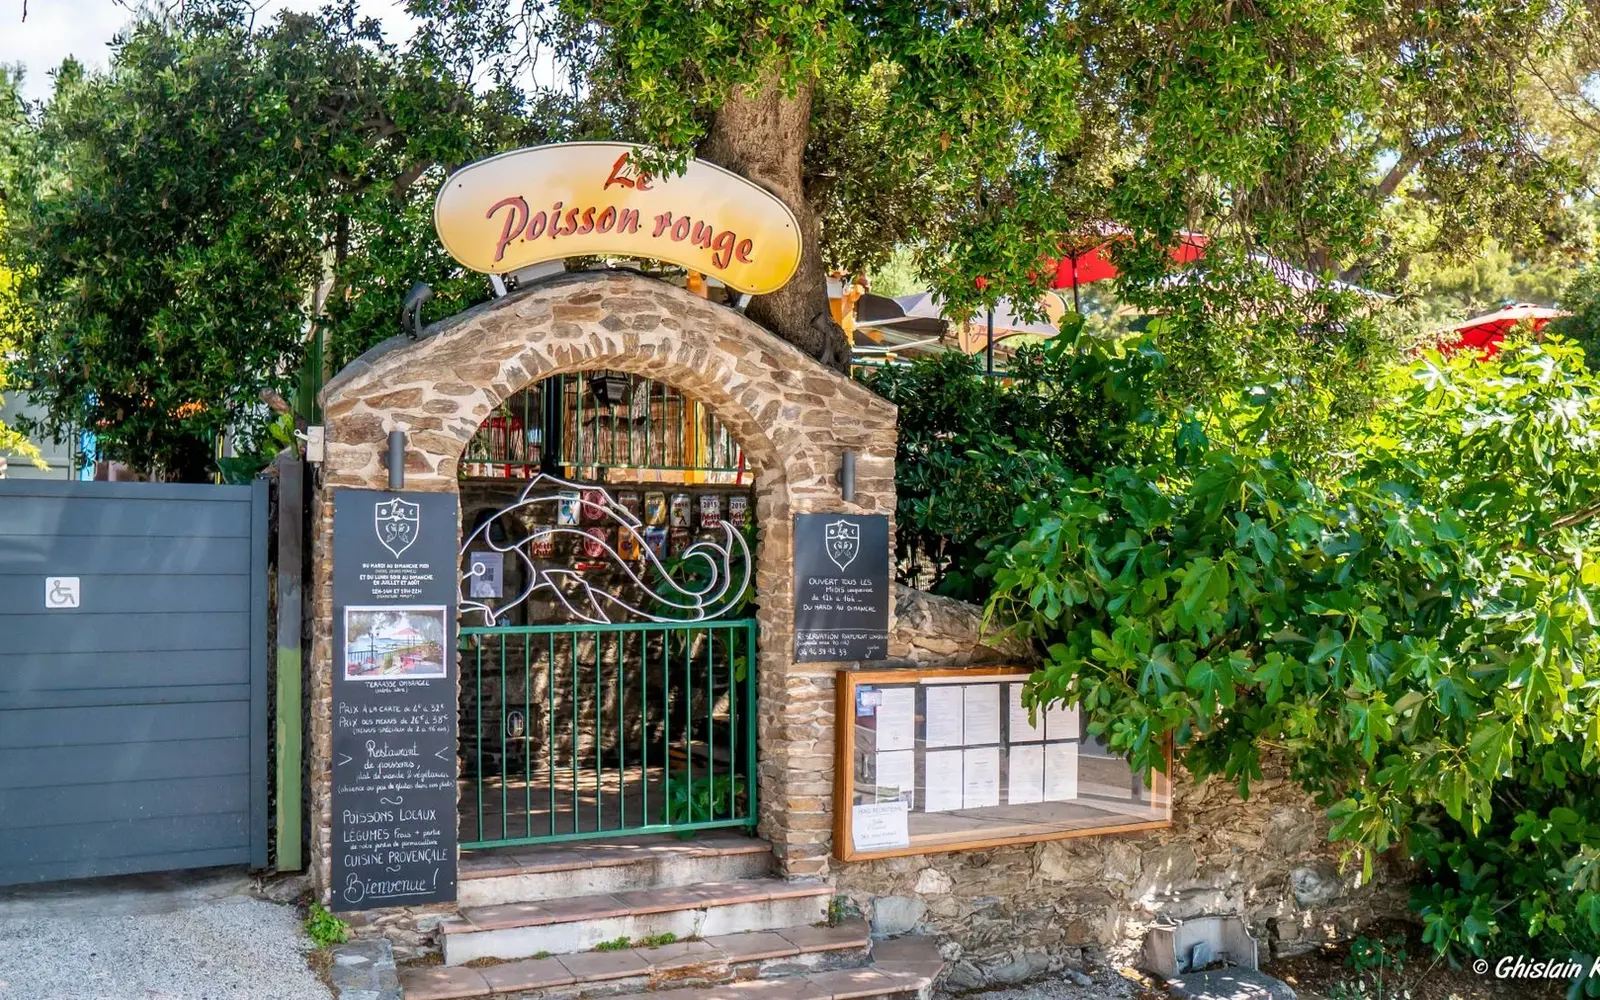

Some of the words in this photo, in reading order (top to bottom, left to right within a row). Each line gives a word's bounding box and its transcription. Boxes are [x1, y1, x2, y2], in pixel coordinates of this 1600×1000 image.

[604, 151, 655, 193] Le
[486, 195, 640, 262] Poisson
[654, 212, 753, 269] rouge
[408, 578, 421, 586] AOÛT
[809, 578, 838, 586] OUVERT
[825, 586, 845, 594] MIDIS
[846, 604, 877, 613] DIMANCHE
[364, 680, 397, 689] TERRASSE
[431, 703, 446, 712] 32€
[415, 724, 420, 732] 2
[428, 723, 436, 732] 16
[365, 739, 420, 758] Restaurant
[363, 758, 375, 770] de
[373, 770, 381, 779] de
[382, 769, 405, 779] viande
[343, 809, 394, 825] POISSONS
[399, 809, 437, 822] LOCAUX
[343, 828, 391, 843] LÉGUMES
[394, 827, 412, 839] Frais
[422, 828, 441, 838] partie
[344, 852, 385, 868] CUISINE
[387, 848, 448, 865] PROVENÇALE
[343, 872, 427, 903] Bienvenue
[432, 867, 440, 890] !
